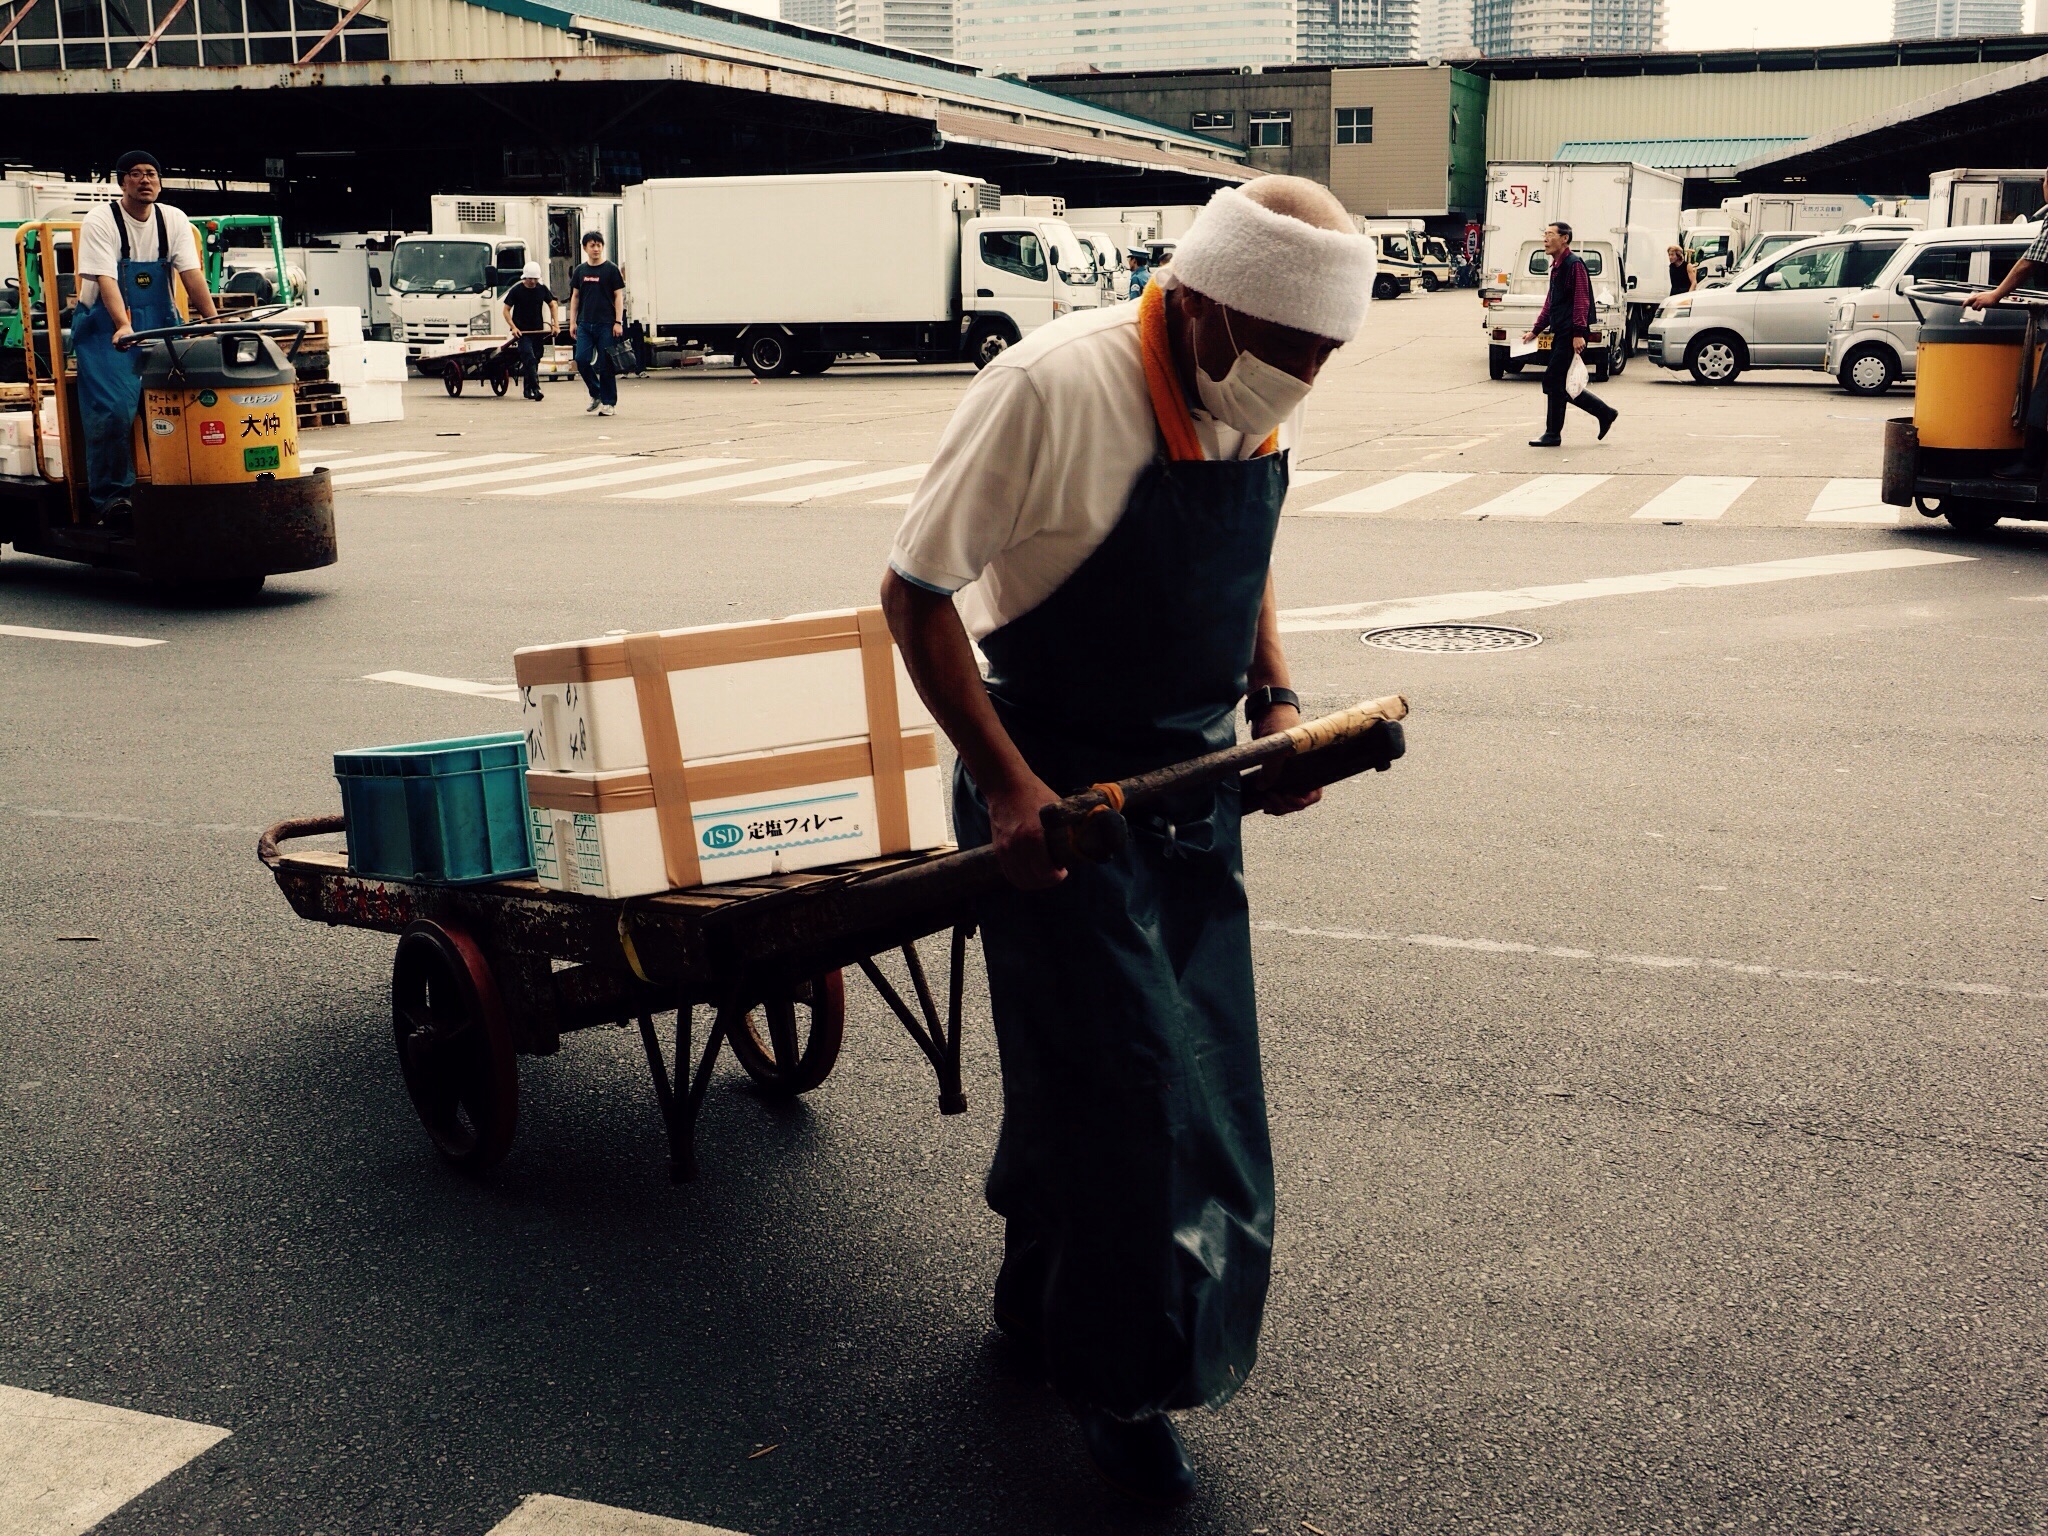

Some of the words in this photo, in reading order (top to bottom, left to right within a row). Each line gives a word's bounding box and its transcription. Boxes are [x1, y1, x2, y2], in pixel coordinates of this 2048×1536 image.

[240, 412, 281, 437] 大仲
[254, 456, 279, 467] 33-26
[707, 827, 740, 846] ISD
[747, 814, 843, 840] 定塩フィレー
